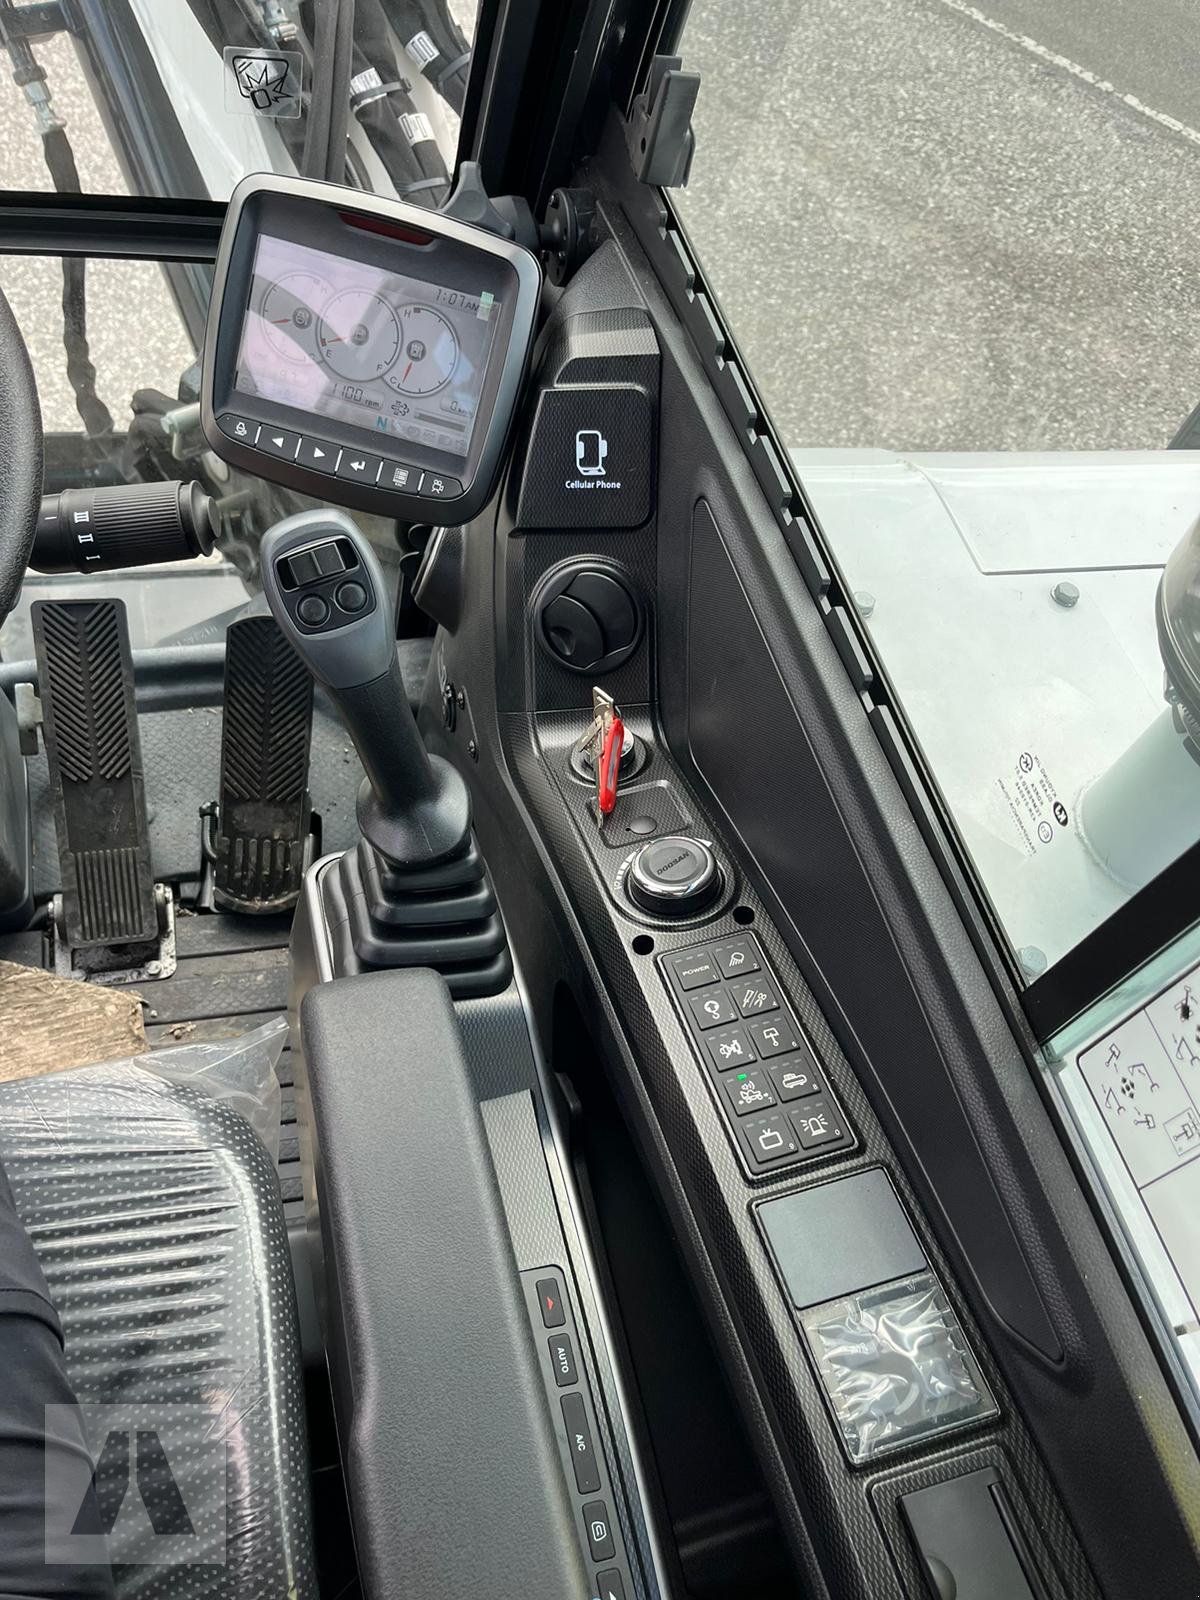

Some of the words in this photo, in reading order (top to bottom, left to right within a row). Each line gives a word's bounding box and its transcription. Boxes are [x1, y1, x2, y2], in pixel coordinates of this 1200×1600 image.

[403, 309, 412, 318] H
[326, 349, 333, 359] E
[376, 363, 383, 372] F
[389, 376, 398, 385] C
[364, 399, 380, 408] rpm
[565, 480, 595, 489] Cellular
[596, 480, 621, 489] Phone
[656, 850, 690, 876] DOOSAN
[682, 964, 710, 977] POWER
[752, 962, 760, 970] 2
[557, 1347, 570, 1374] AUTO
[575, 1433, 586, 1452] A/C
